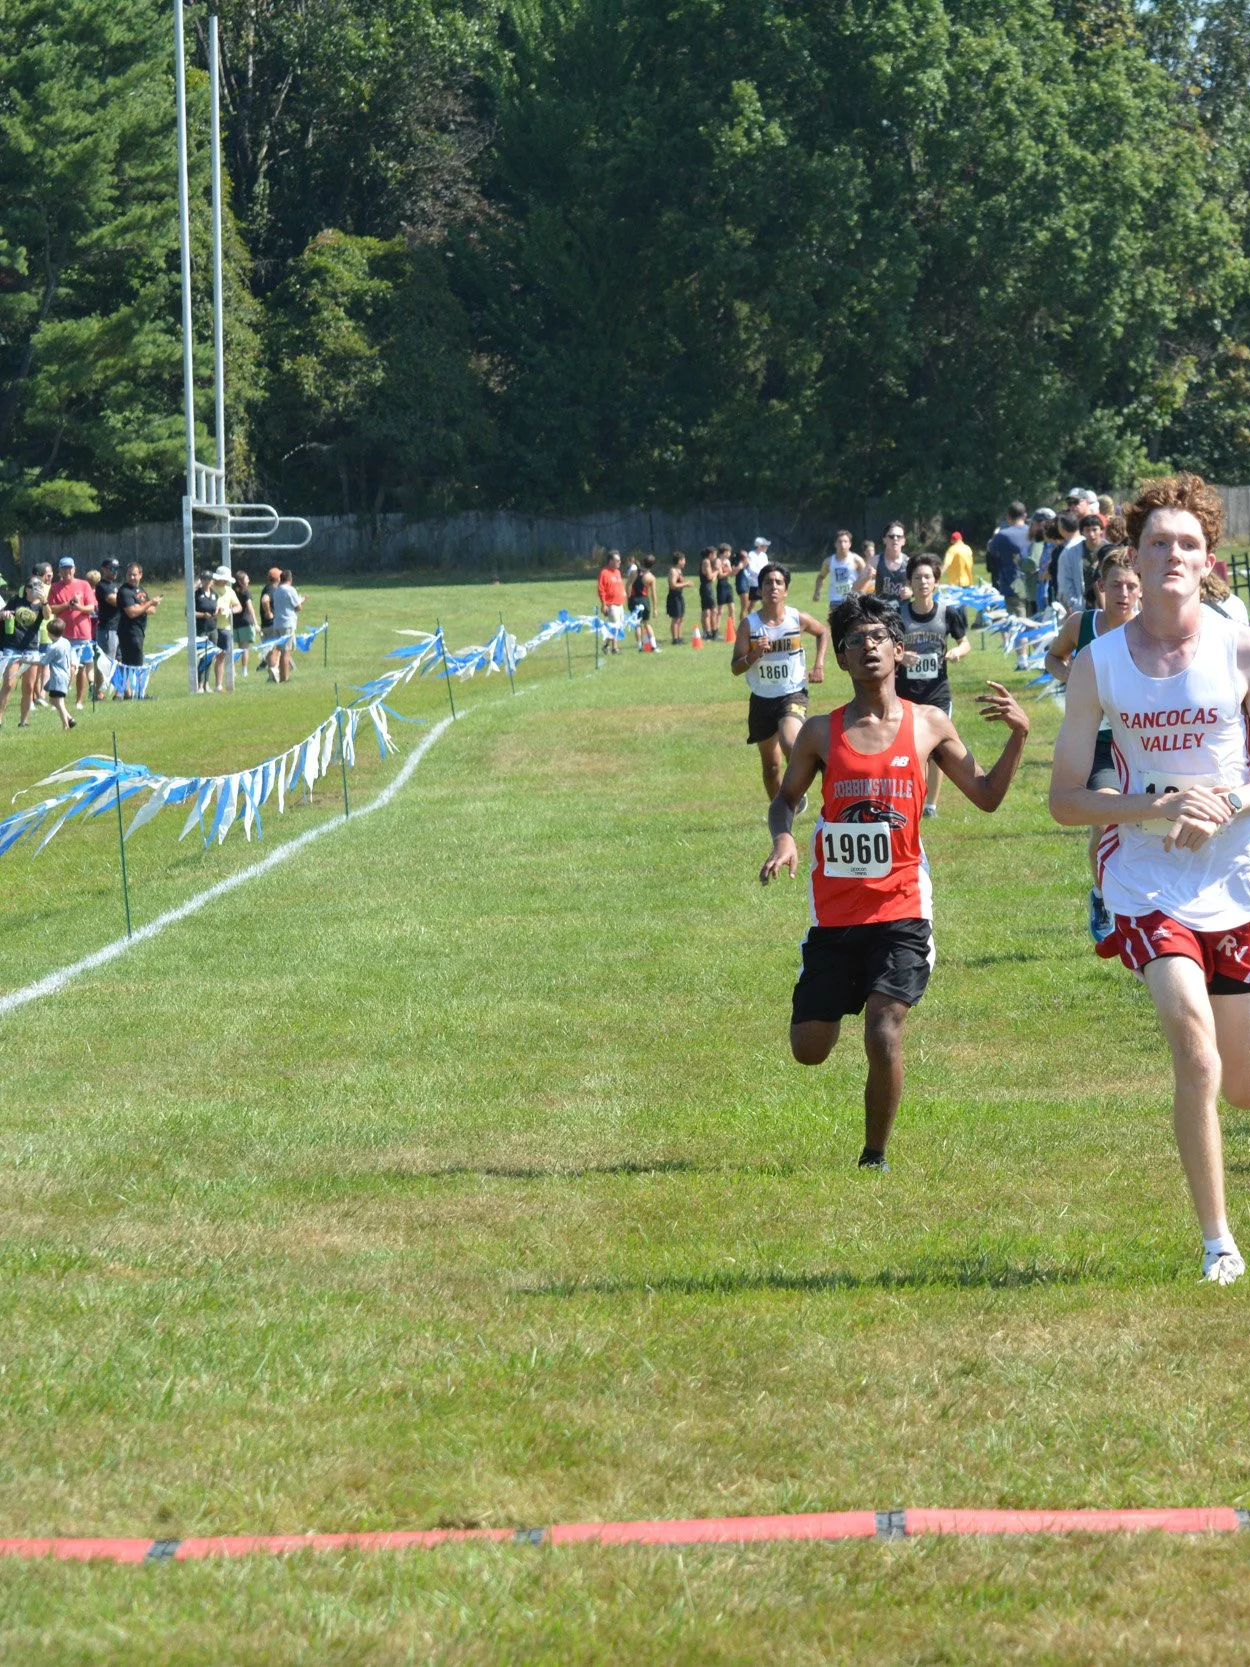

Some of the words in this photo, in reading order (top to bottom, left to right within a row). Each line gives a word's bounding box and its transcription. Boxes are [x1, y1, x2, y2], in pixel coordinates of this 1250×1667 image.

[759, 664, 789, 679] 1860
[1120, 707, 1218, 729] RANCOCAS
[1140, 732, 1205, 752] VALLEY
[824, 832, 889, 865] 1960
